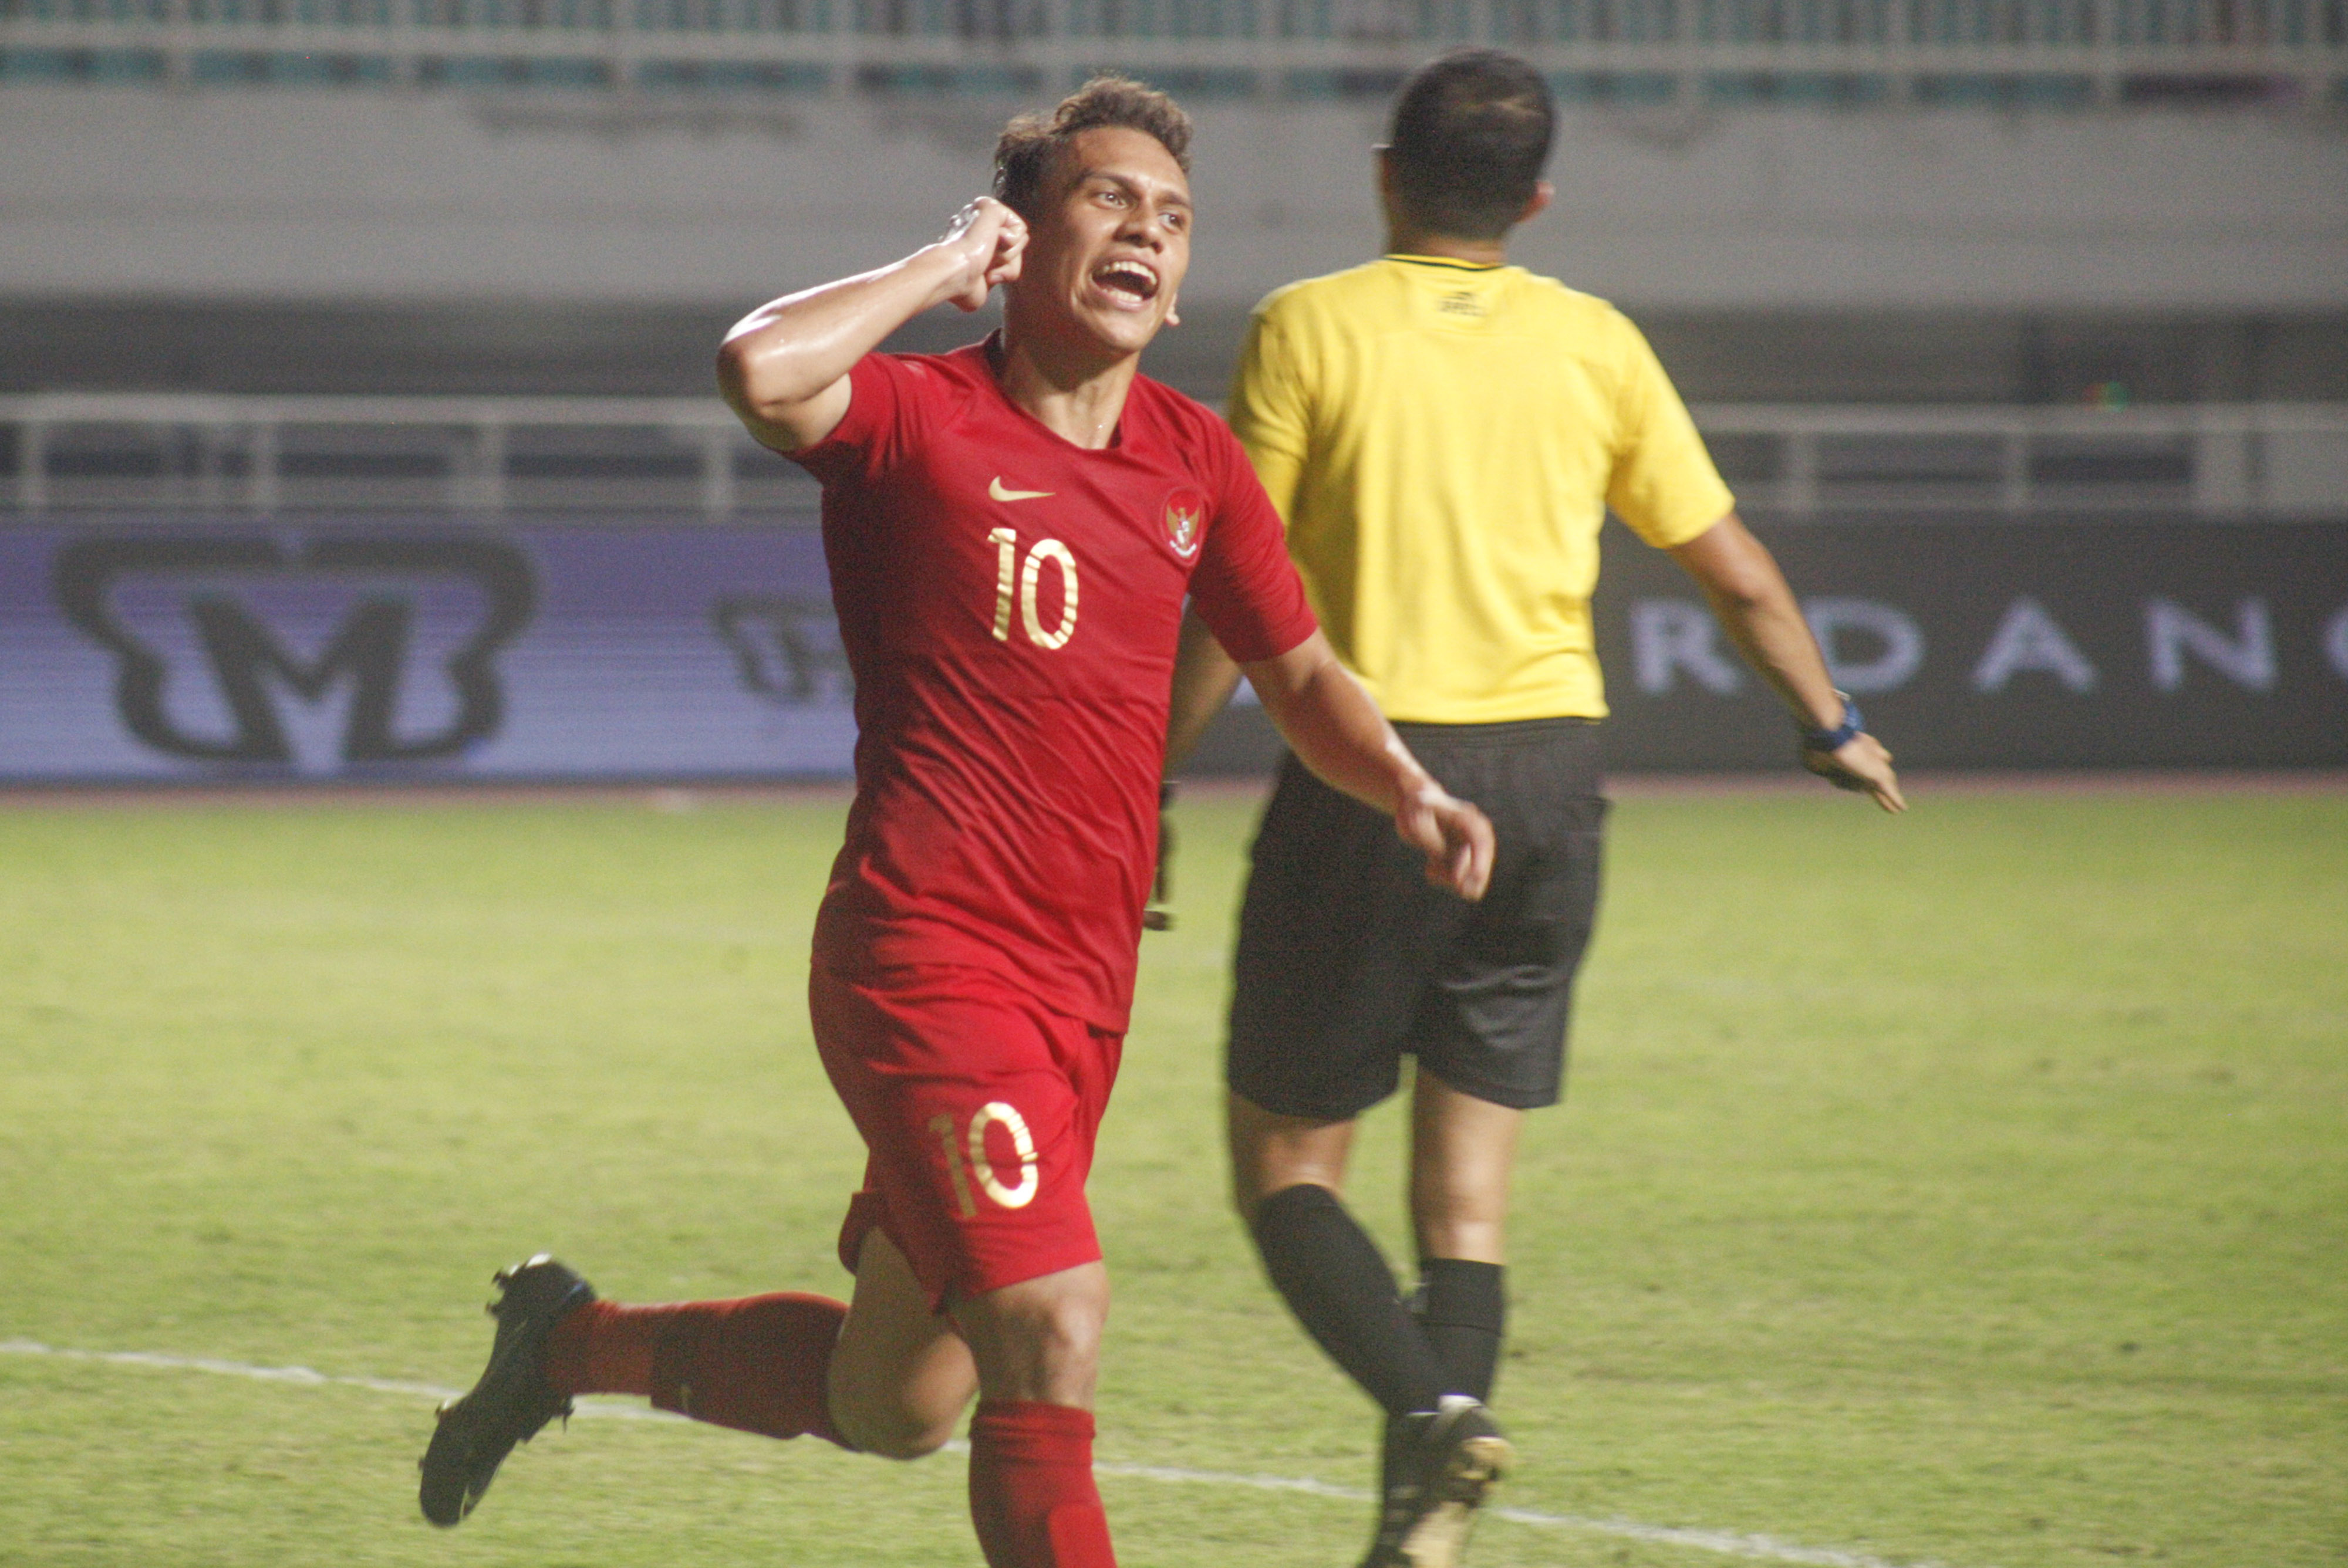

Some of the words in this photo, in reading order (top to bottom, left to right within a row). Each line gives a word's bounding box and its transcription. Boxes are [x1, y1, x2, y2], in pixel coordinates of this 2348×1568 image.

[988, 527, 1078, 650] 10
[1632, 597, 2348, 694] RDAN
[929, 1101, 1038, 1218] 10
